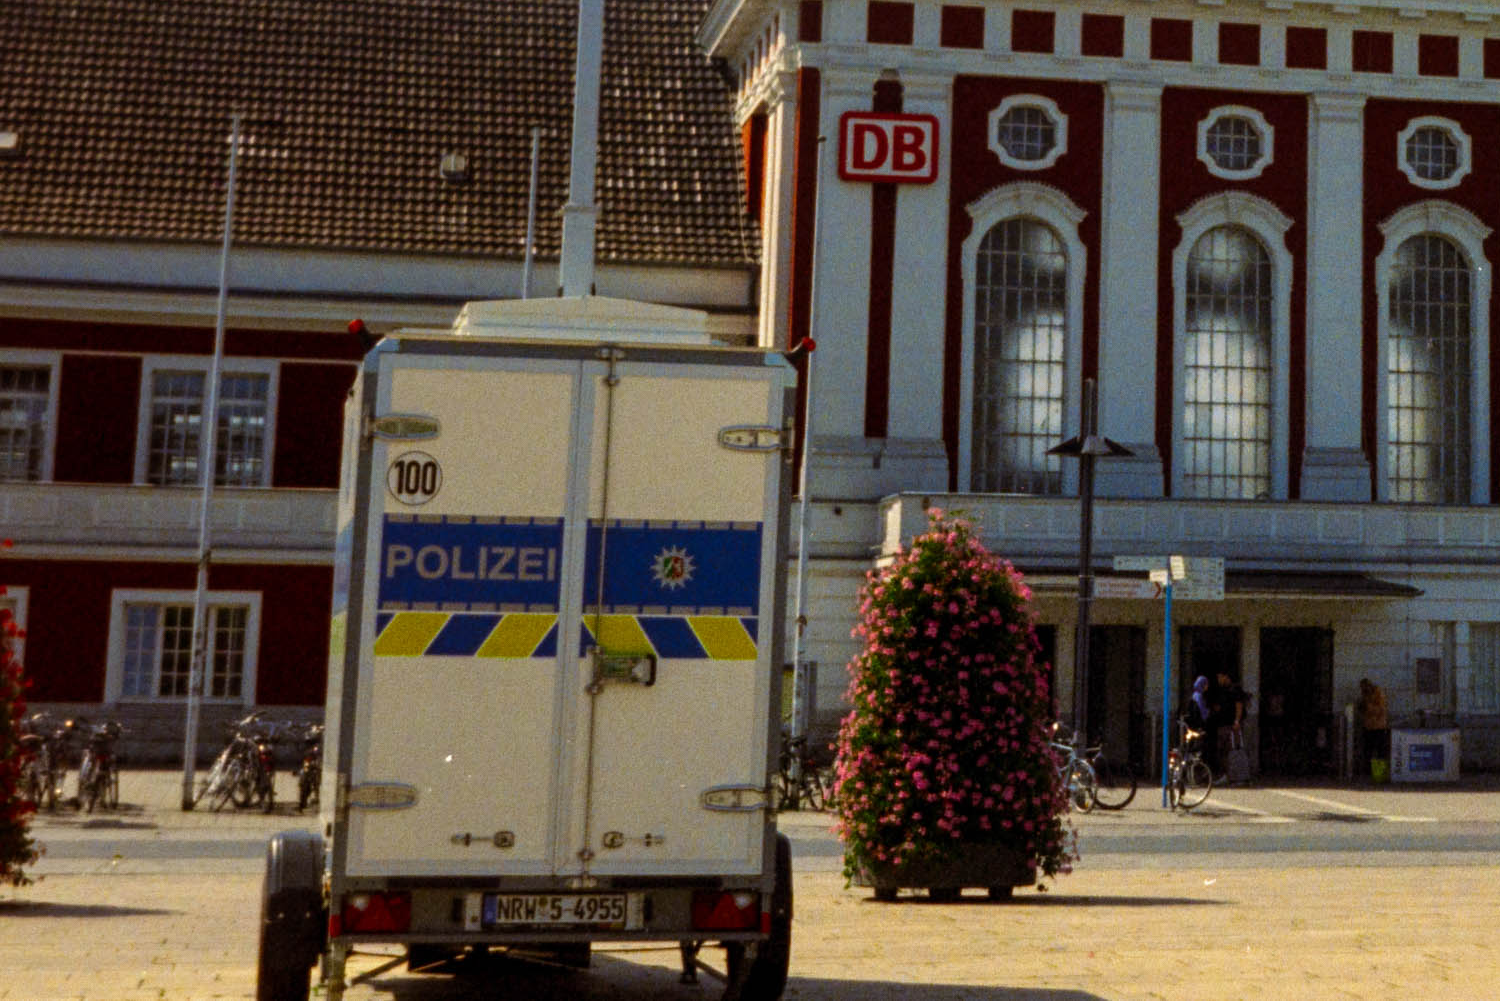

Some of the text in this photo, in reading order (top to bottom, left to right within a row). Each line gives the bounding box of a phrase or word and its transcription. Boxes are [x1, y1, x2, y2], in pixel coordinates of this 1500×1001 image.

[852, 124, 926, 172] DB
[394, 460, 438, 496] 100
[385, 544, 557, 581] POLIZEI
[497, 897, 624, 920] NRW 5-4955
